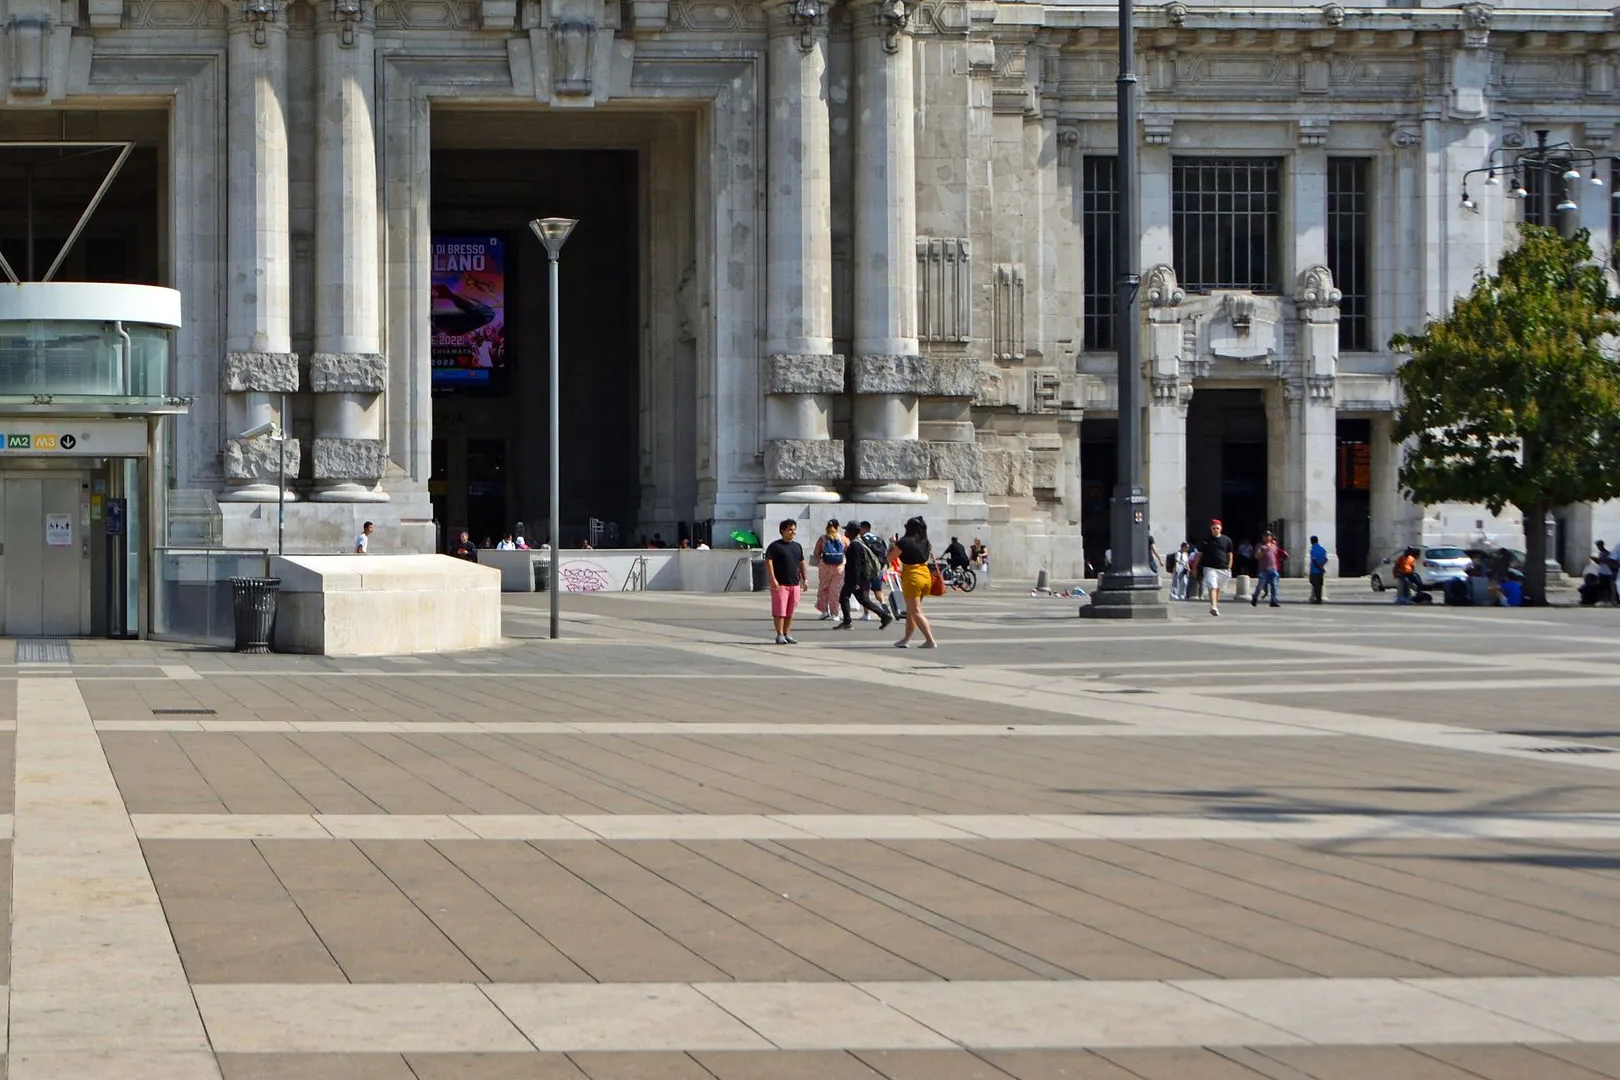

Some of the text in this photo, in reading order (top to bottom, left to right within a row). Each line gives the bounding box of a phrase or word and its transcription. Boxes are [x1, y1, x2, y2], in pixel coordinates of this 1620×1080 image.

[436, 244, 446, 255] DI
[448, 244, 485, 255] BRESSO
[439, 335, 463, 345] 2022
[9, 437, 55, 446] M2 M3
